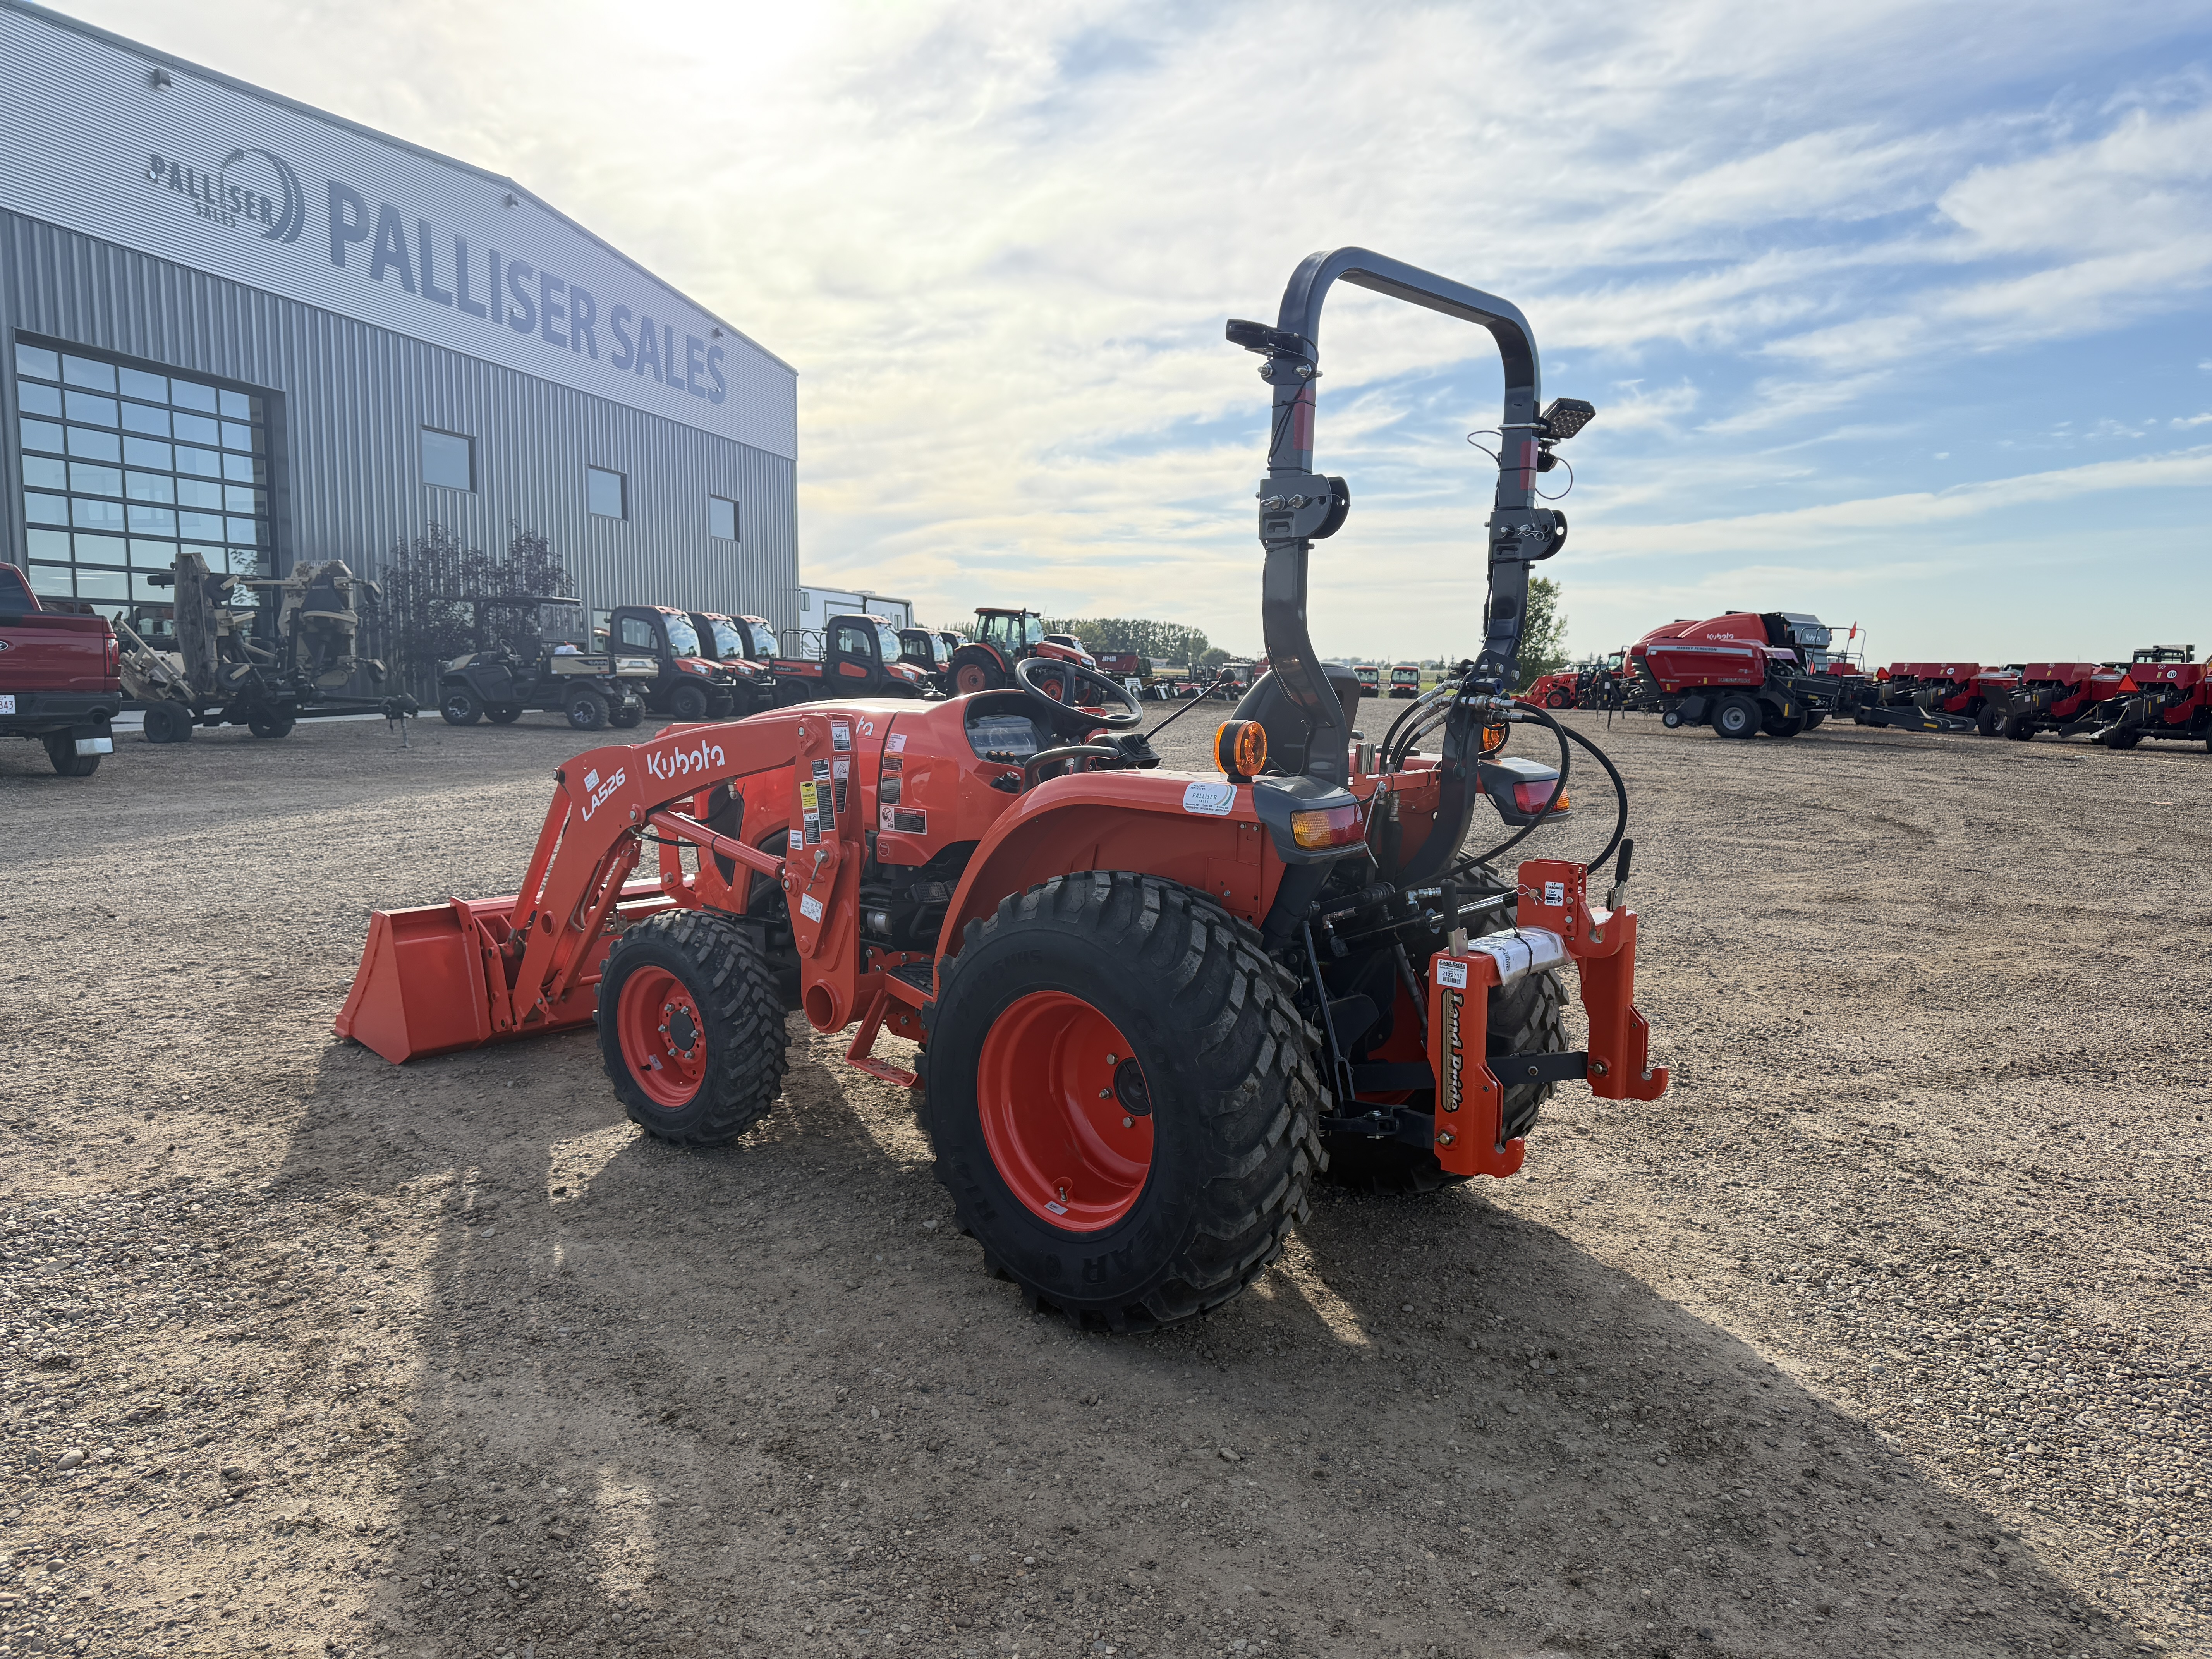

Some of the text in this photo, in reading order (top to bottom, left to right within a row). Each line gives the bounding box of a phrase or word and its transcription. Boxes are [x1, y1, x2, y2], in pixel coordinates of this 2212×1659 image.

[148, 153, 274, 226] PALLISER
[195, 203, 237, 228] SALES
[329, 180, 726, 405] PALLISER SALES
[647, 740, 725, 780] Kubota
[582, 767, 625, 821] LA526
[1447, 991, 1464, 1111] Land Pride
